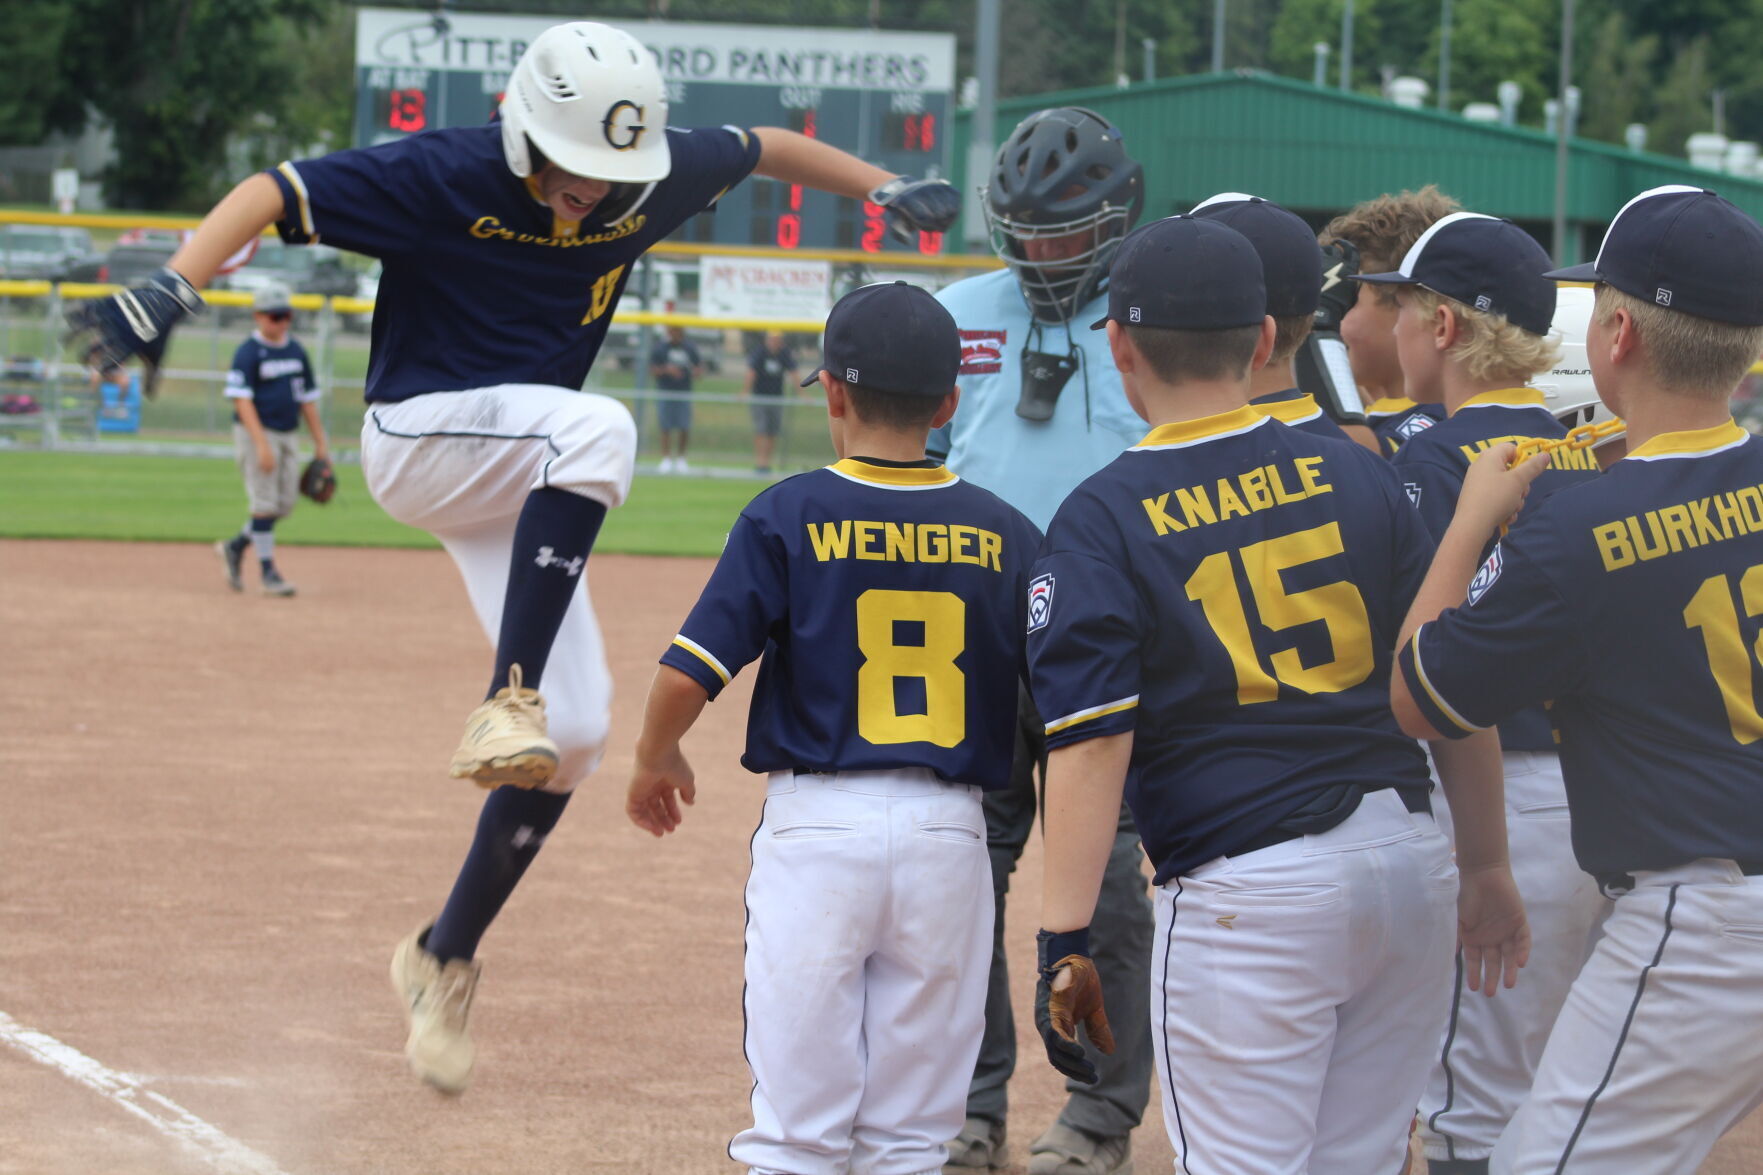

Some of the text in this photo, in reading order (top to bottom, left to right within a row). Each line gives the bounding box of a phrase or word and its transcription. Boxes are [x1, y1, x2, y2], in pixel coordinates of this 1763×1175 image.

[729, 48, 928, 86] PANTHERS
[601, 99, 648, 151] G
[777, 213, 801, 249] 0
[861, 217, 886, 252] 2
[1552, 368, 1592, 376] RAWLIN
[1142, 456, 1333, 536] KNABLE
[807, 520, 1002, 573] WENGER
[1592, 483, 1763, 572] BURKHO
[1184, 521, 1375, 706] 15
[857, 589, 965, 748] 8
